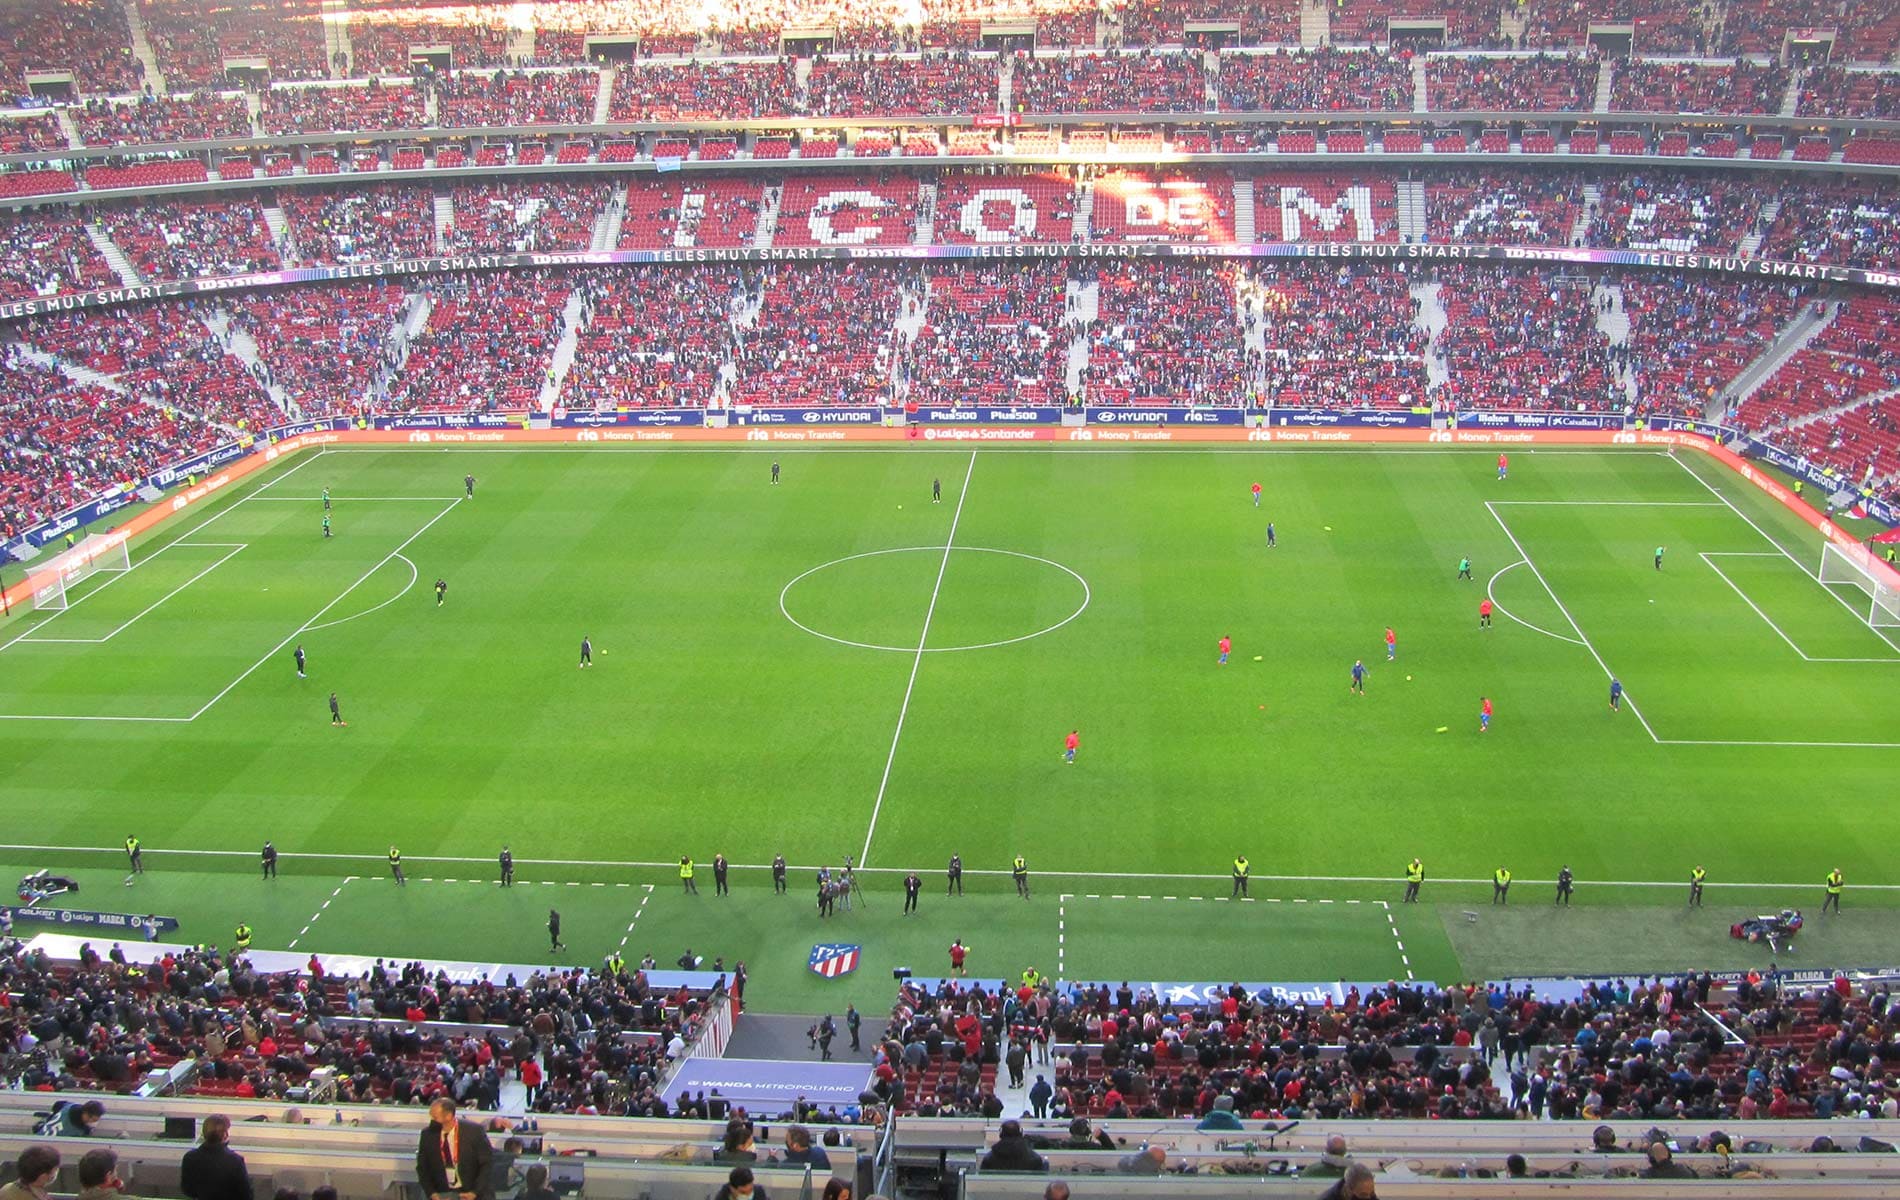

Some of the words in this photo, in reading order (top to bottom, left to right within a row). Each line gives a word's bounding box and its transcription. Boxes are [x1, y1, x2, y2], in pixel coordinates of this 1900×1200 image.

[652, 250, 705, 262] TELES
[715, 249, 751, 261] MUY
[760, 248, 818, 260] SMART
[971, 246, 1024, 257] TELES
[1034, 246, 1070, 256] MUY
[1079, 246, 1139, 256] SMART
[1295, 246, 1351, 256] TELES
[1361, 246, 1399, 257] MUY
[1409, 246, 1471, 258] SMART
[327, 264, 383, 279] TELES
[393, 261, 430, 274] MUY
[440, 257, 500, 270] SMART
[1638, 254, 1698, 268] TELES
[1709, 258, 1750, 272] MUY
[1760, 262, 1829, 279] SMART
[47, 295, 87, 311] MUY
[97, 286, 162, 305] SMART
[752, 410, 771, 422] ria
[822, 412, 871, 421] HYUNDAI
[931, 410, 977, 420] Plus500
[990, 410, 1037, 420] Plus500
[1184, 409, 1203, 421] ria
[1293, 414, 1315, 422] capital
[1361, 415, 1384, 423] capital
[1384, 416, 1407, 424] energy
[1563, 418, 1598, 426] CaixaBank
[409, 429, 431, 442] ria
[435, 433, 465, 442] Money
[467, 431, 504, 440] Transfer
[577, 429, 598, 441] ria
[603, 432, 634, 440] Money
[636, 431, 674, 440] Transfer
[747, 428, 768, 441] ria
[774, 431, 805, 440] Money
[808, 430, 847, 439] Transfer
[937, 429, 970, 439] LaLiga
[980, 429, 1035, 439] Santander
[1070, 428, 1092, 441] ria
[1098, 431, 1130, 440] Money
[1133, 430, 1172, 440] Transfer
[1248, 428, 1271, 441] ria
[1277, 431, 1309, 441] Money
[1312, 430, 1352, 440] Transfer
[1429, 429, 1452, 442] ria
[1458, 432, 1491, 442] Money
[1494, 431, 1535, 441] Transfer
[1807, 467, 1838, 491] Acronis
[96, 500, 111, 516] ria
[42, 517, 78, 541] Plus500
[99, 914, 125, 925] MARCA
[702, 1080, 752, 1089] WANDA
[755, 1082, 854, 1092] METROPOLITANO
